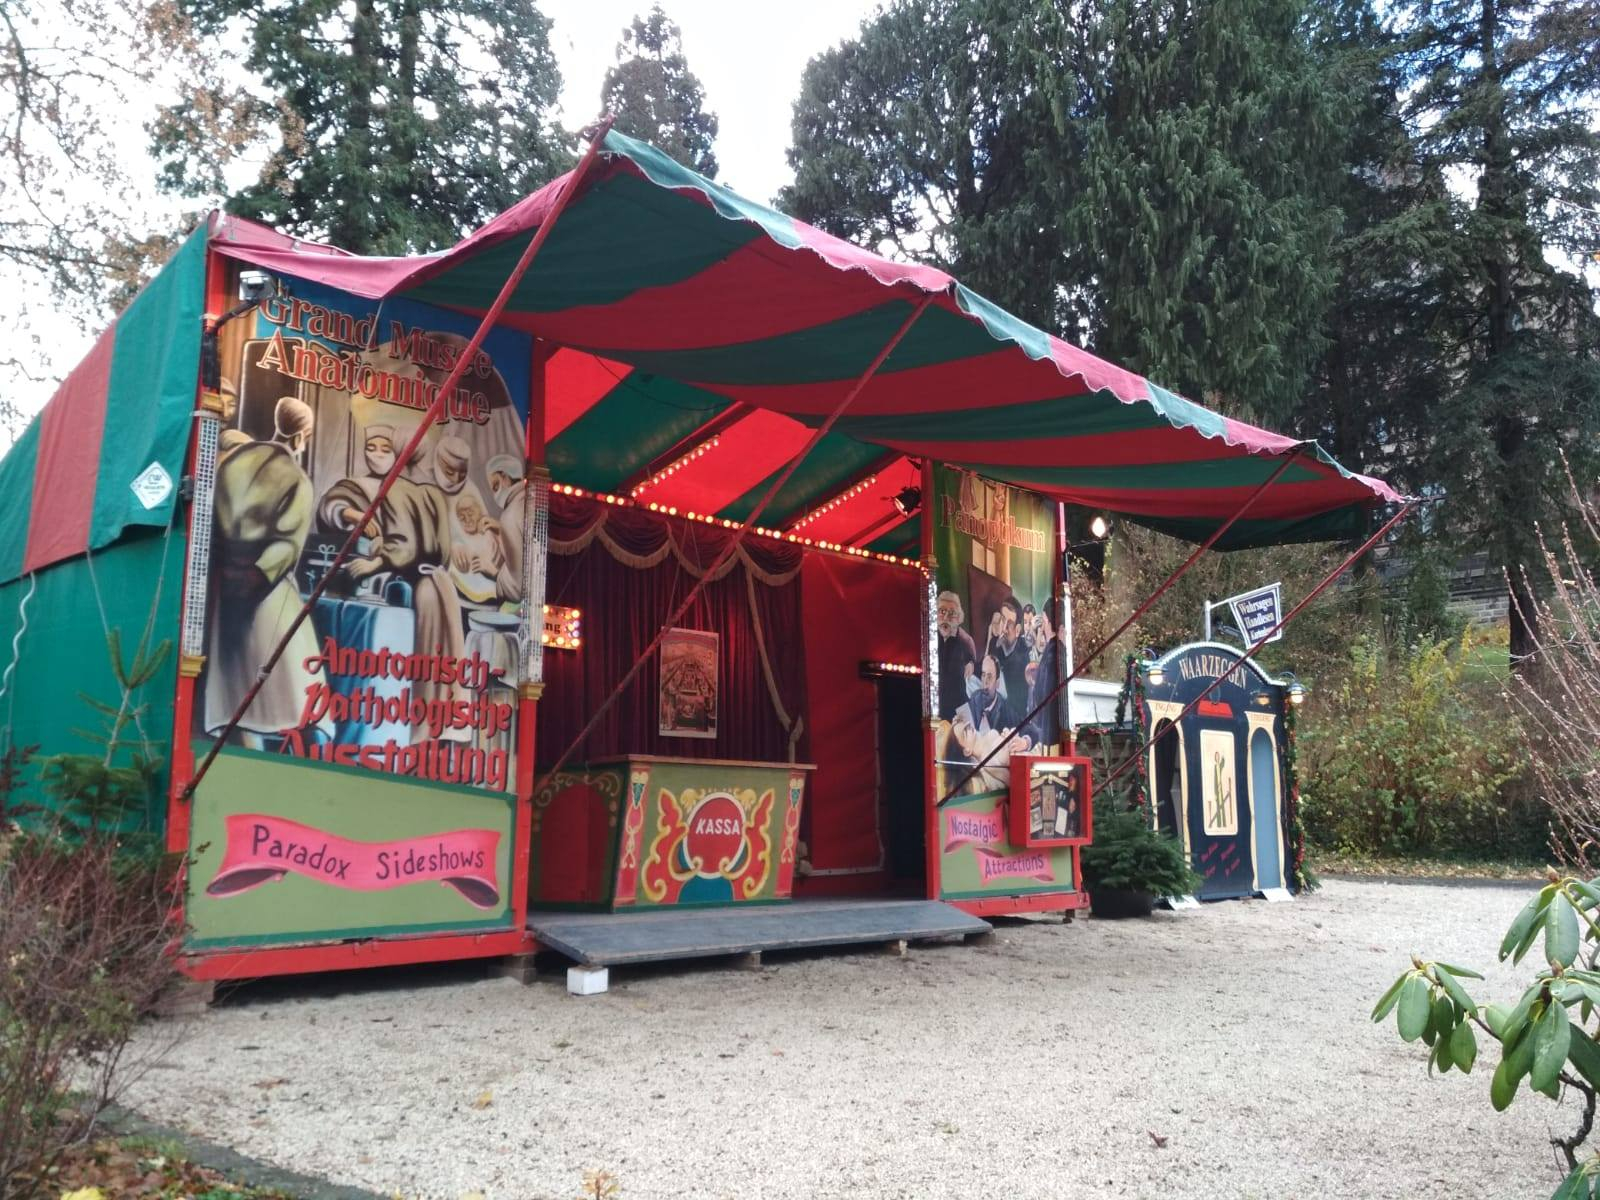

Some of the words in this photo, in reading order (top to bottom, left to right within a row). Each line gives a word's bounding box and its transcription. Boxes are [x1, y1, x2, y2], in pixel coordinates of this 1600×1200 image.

[257, 279, 380, 351] Grand
[256, 326, 491, 426] Anatomique
[940, 494, 1046, 552] Panoptikum
[1179, 655, 1248, 690] WAARZEGGEN
[301, 682, 512, 738] Pathologische
[252, 824, 351, 881] Paradox
[376, 844, 485, 880] Sideshows
[695, 818, 741, 836] KASSA
[951, 816, 998, 843] Nostalgic
[984, 854, 1044, 879] Attractions
